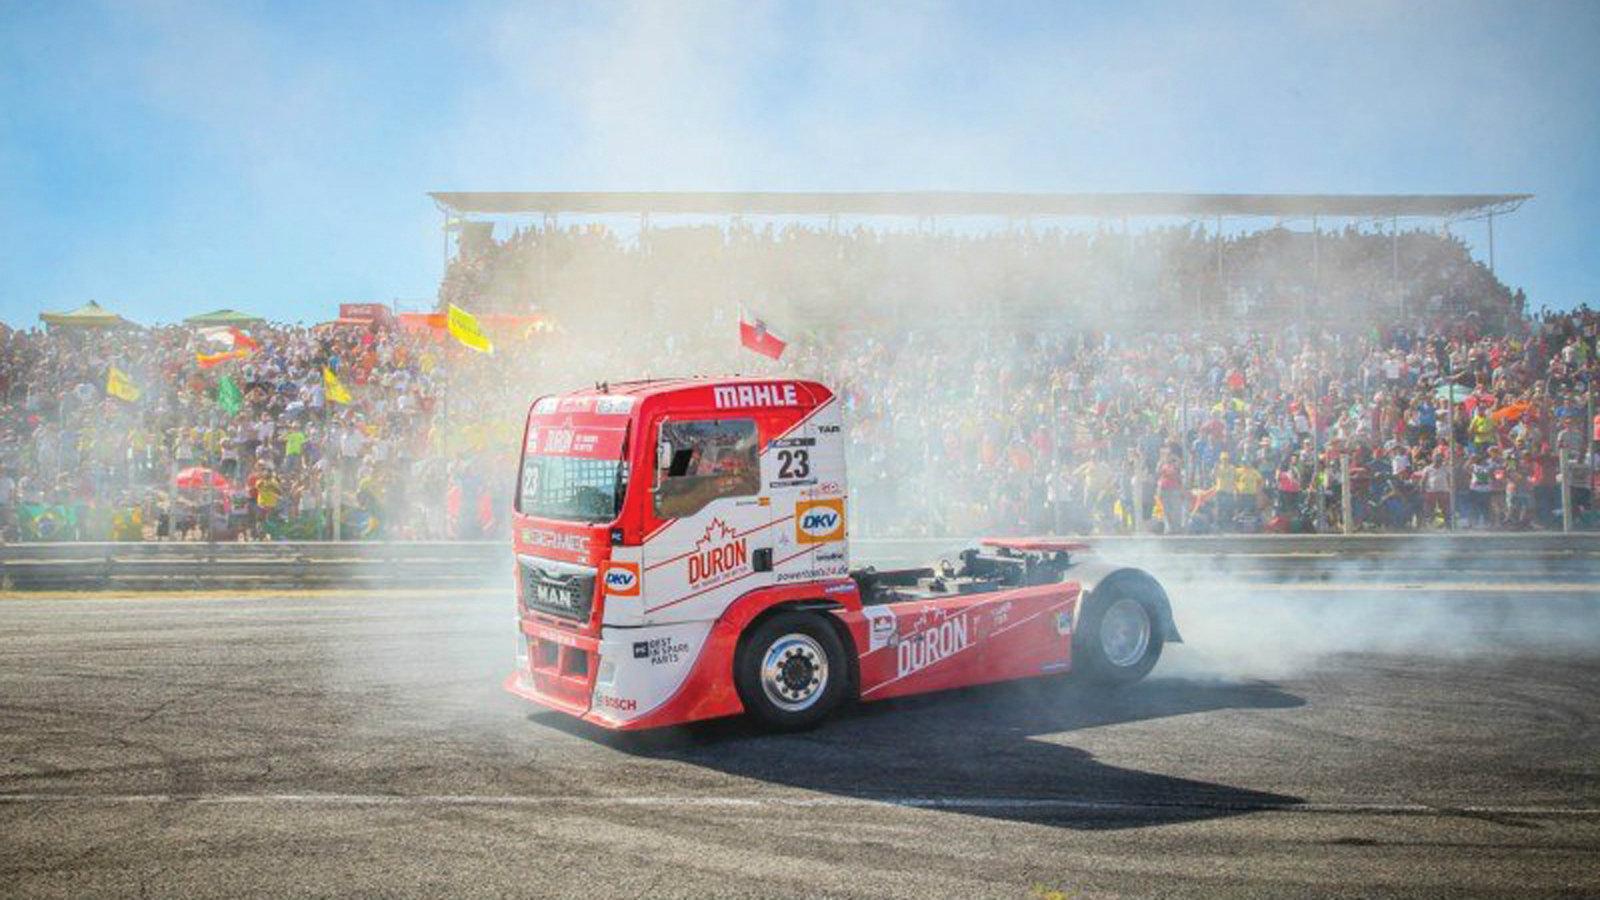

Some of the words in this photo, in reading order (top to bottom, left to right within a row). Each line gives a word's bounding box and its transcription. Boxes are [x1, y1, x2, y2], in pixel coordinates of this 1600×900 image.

[714, 384, 798, 408] MAHLE
[777, 450, 809, 478] 23
[803, 513, 838, 529] DKV
[688, 537, 747, 585] DURON
[604, 573, 634, 585] DKV
[537, 584, 571, 608] MAN
[650, 637, 671, 649] BEST
[896, 613, 968, 678] DURON
[651, 654, 679, 665] PARTS
